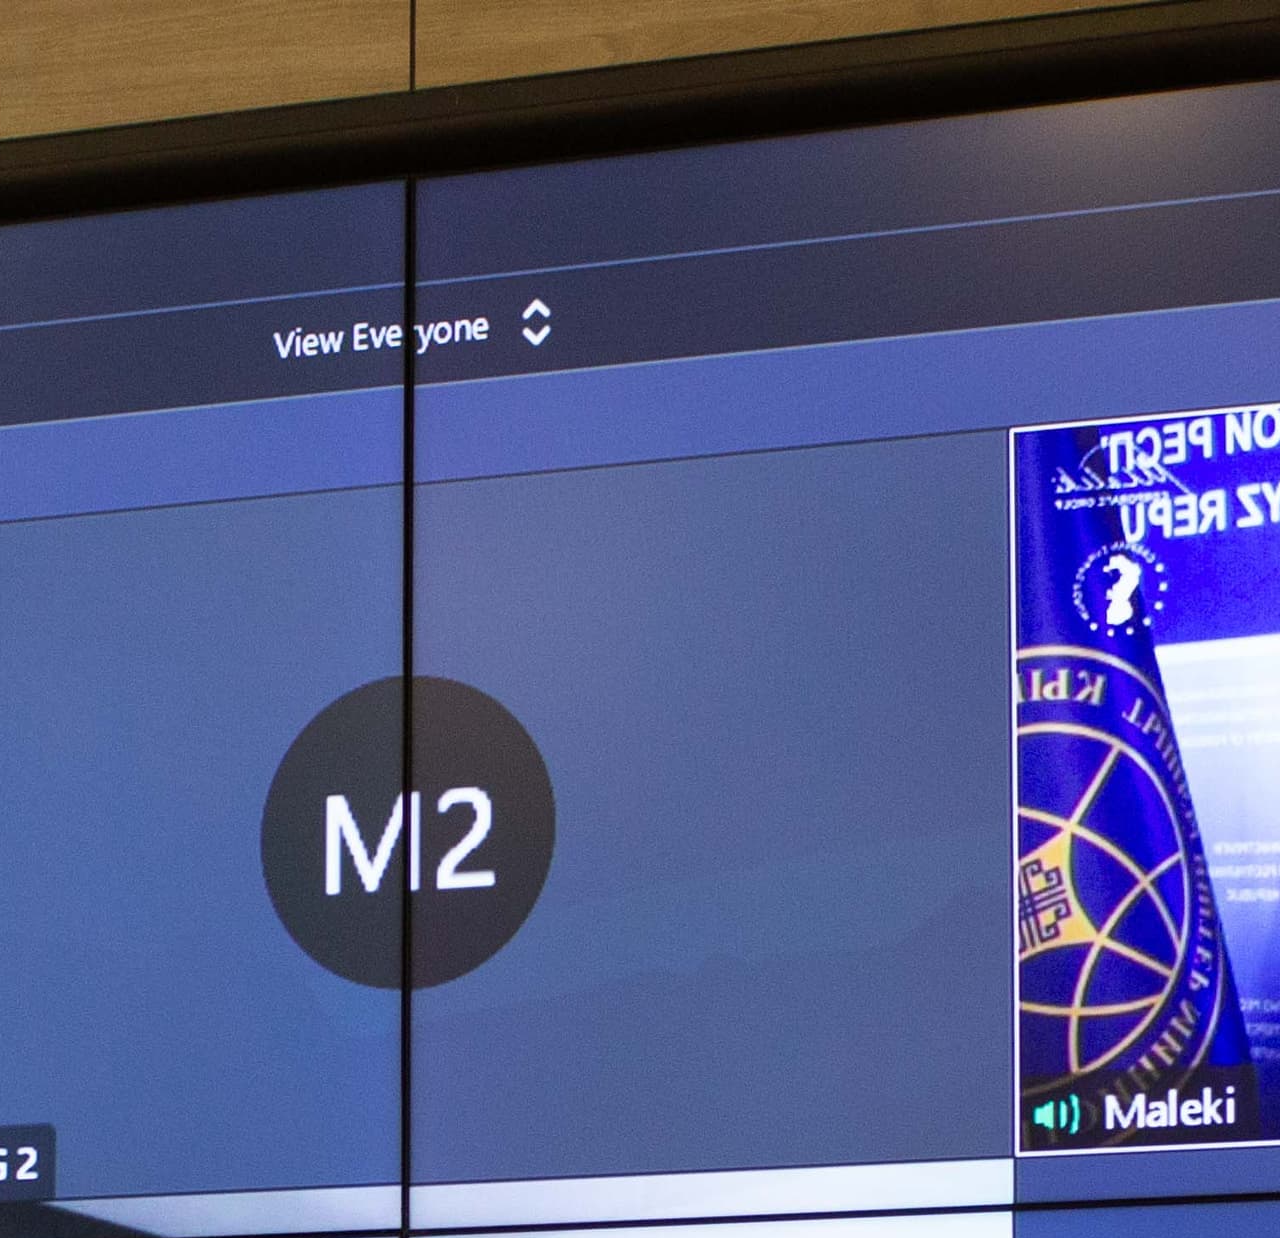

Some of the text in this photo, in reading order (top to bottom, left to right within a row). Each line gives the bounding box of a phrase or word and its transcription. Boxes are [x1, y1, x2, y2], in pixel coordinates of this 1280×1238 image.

[273, 316, 490, 358] View Eveyone
[324, 786, 497, 896] M2
[1104, 1085, 1236, 1130] Maleki
[16, 1146, 38, 1181] 2
